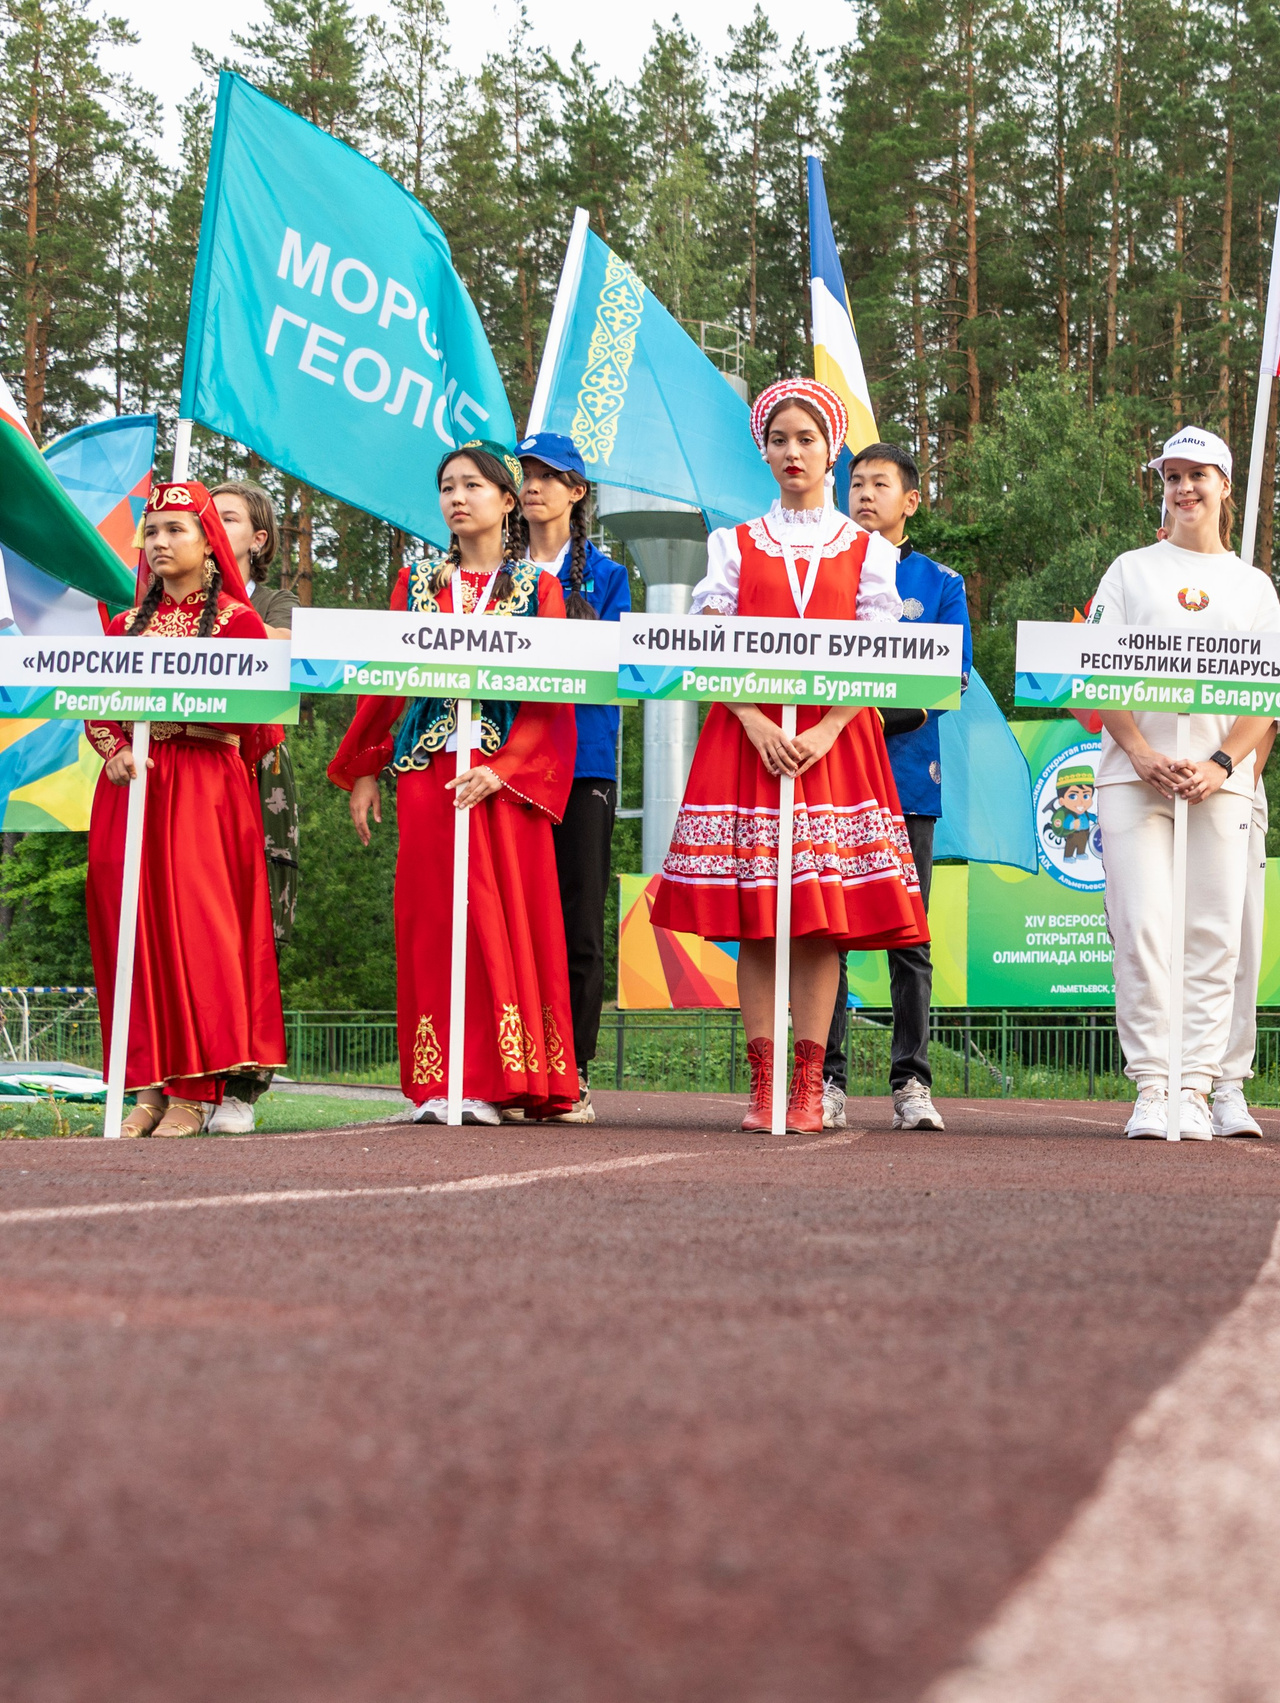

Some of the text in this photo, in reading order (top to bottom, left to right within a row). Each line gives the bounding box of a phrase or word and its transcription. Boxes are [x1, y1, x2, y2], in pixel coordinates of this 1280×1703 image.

[401, 627, 532, 653] «САРМАТ»
[632, 625, 950, 660] «ЮНЫЙ ГЕОЛОГ БУРЯТИИ»
[1117, 633, 1261, 655] «ЮНЫЕ ГЕОЛОГИ
[23, 650, 269, 676] «МОРСКИЕ ГЕОЛОГИ»
[1080, 652, 1191, 673] РЕСПУБЛИКИ
[343, 664, 587, 695] Республика Казахстан
[682, 670, 897, 701] Республика Бурятия
[1071, 678, 1194, 705] Республика
[54, 690, 227, 717] Республика Крым
[1025, 914, 1106, 928] XIV ВСЕРОСС
[1026, 932, 1094, 946] ОТКРЫТАЯ
[993, 950, 1077, 965] ОЛИМПИАДА
